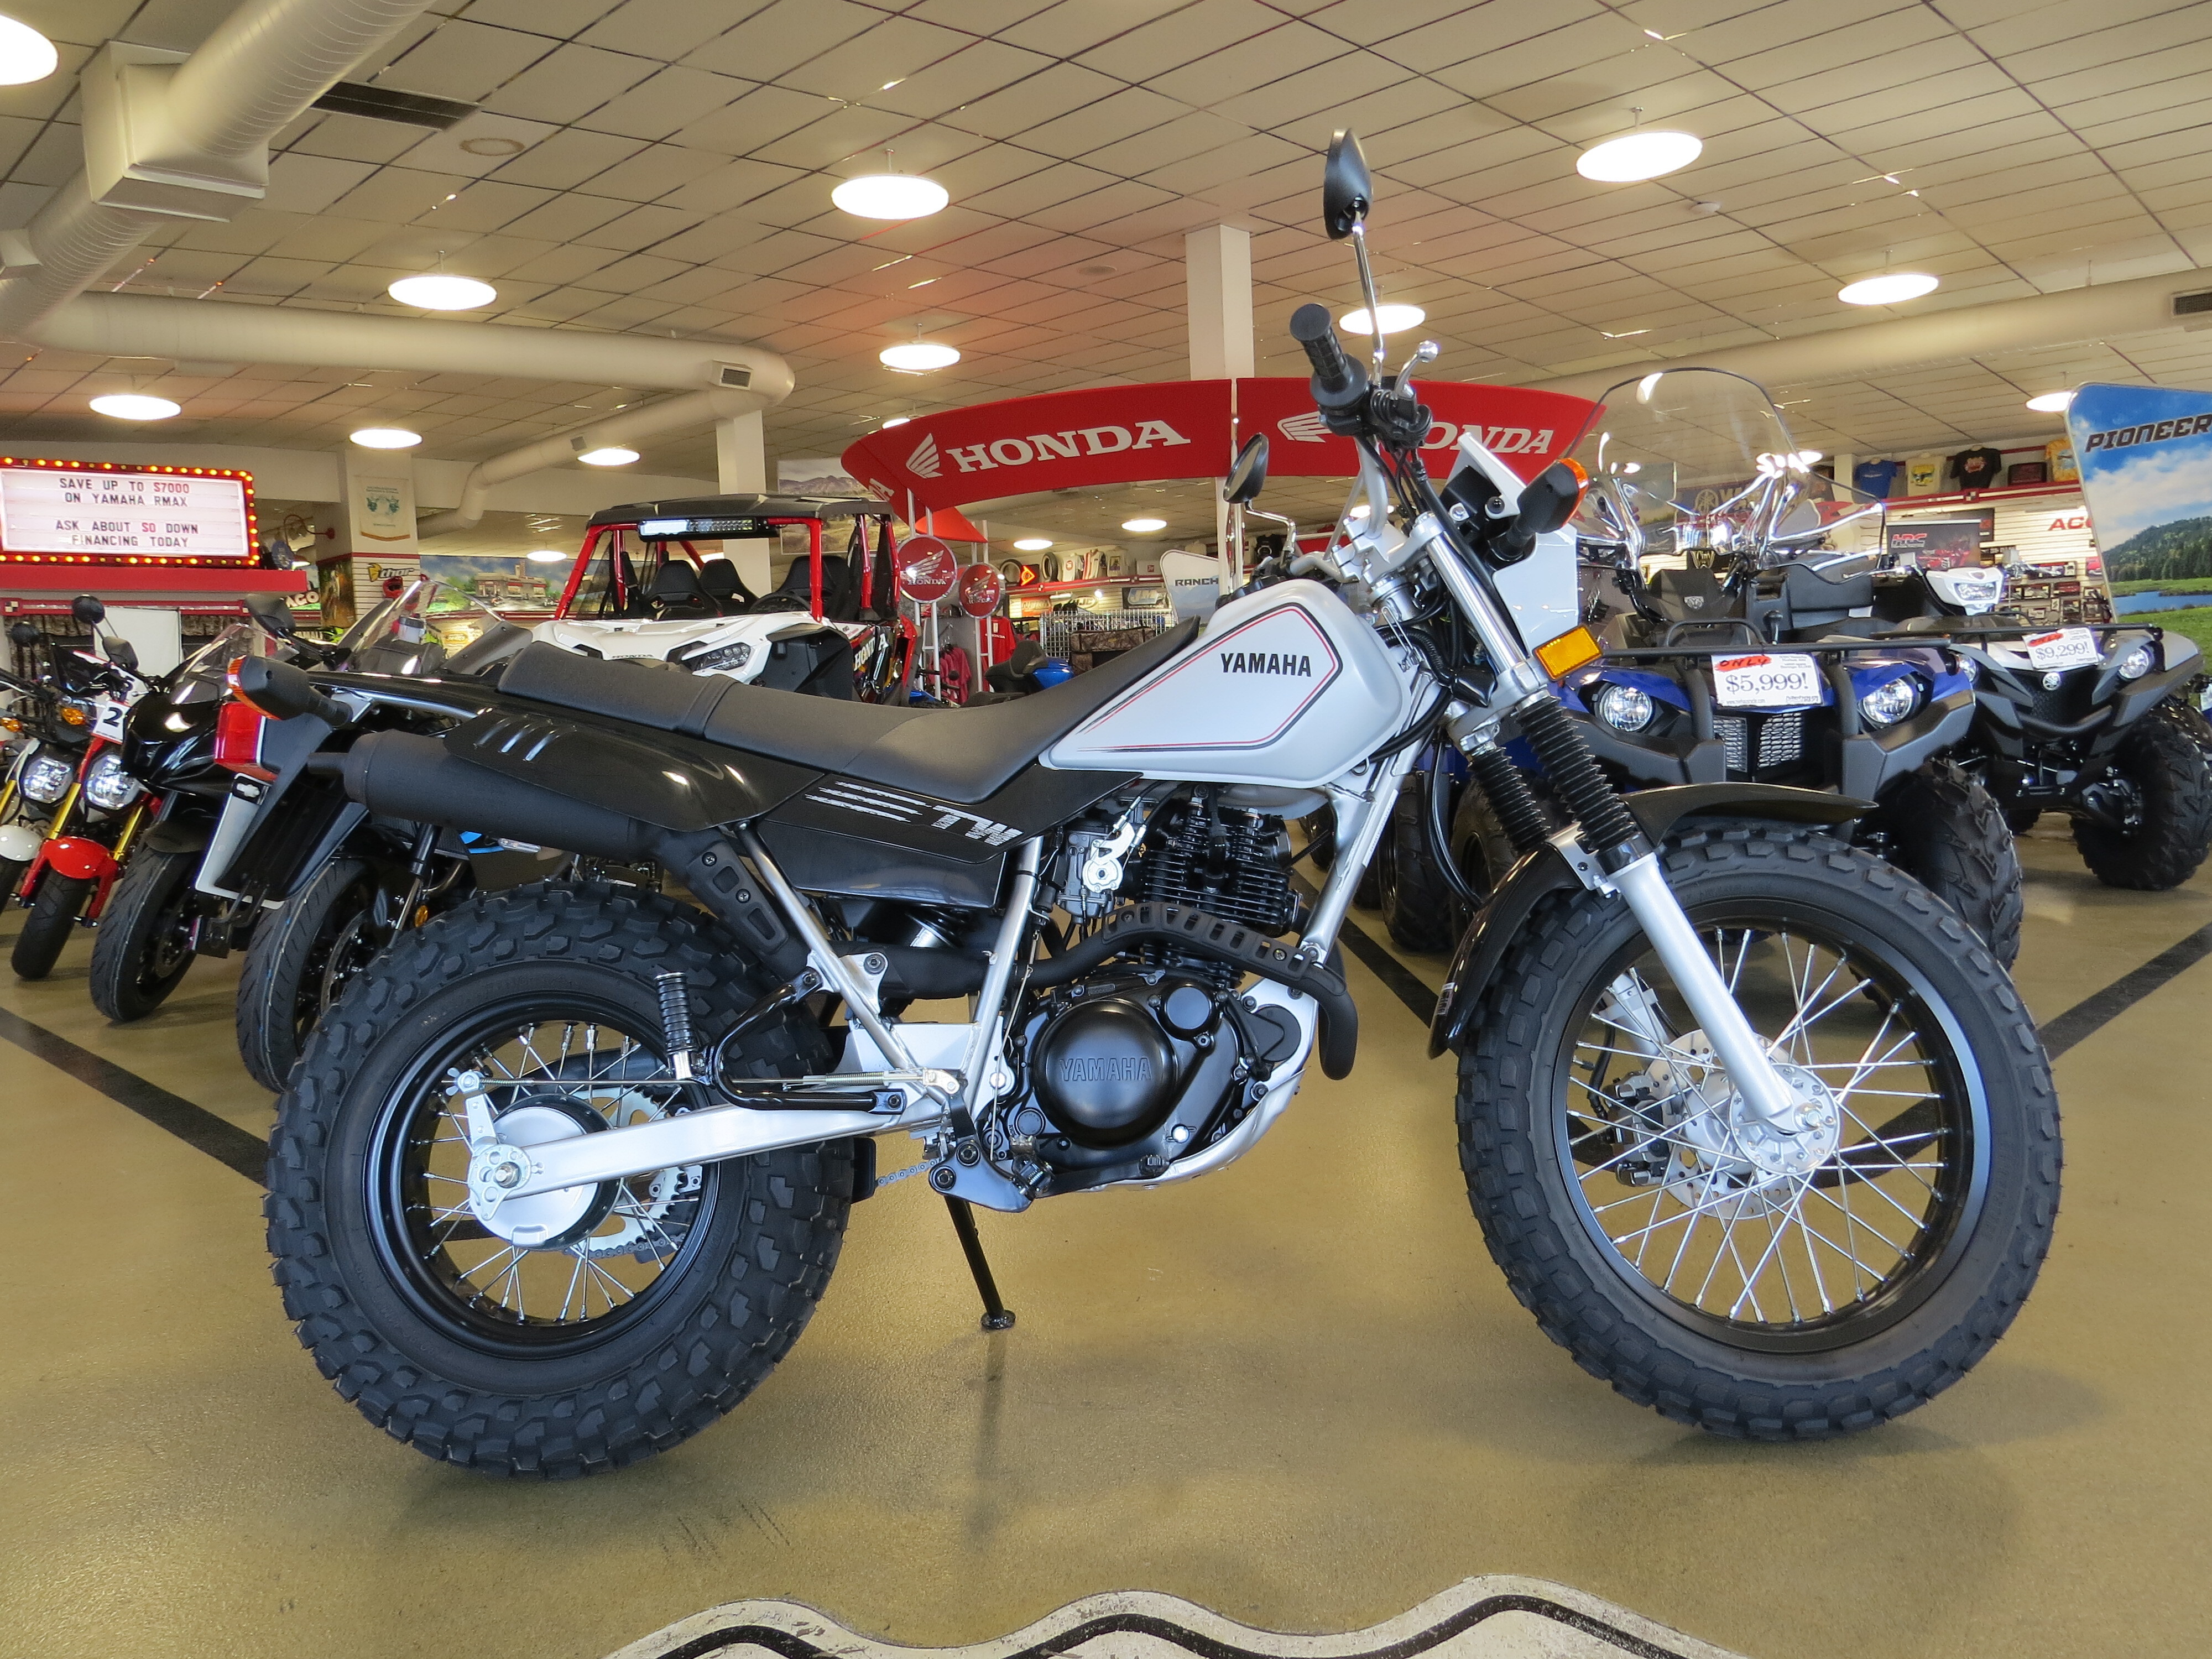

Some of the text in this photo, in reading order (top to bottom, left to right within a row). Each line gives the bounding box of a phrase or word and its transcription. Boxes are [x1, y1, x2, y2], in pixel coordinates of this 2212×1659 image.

[1418, 421, 1554, 455] ONDA
[2084, 414, 2212, 453] PIONEER
[945, 419, 1191, 473] HONDA
[59, 478, 93, 489] SAVE
[103, 480, 118, 491] UP
[129, 481, 144, 492] TO
[65, 492, 189, 507] ON YAMAHA RMAX
[55, 520, 80, 531] ASK
[91, 521, 131, 533] ABOUT
[166, 523, 199, 534] DOWN
[71, 534, 189, 547] FINANCING TODAY
[2035, 641, 2090, 661] $9,299!
[1220, 653, 1312, 677] YAMAHA
[1719, 658, 1768, 668] ONLY
[1725, 672, 1809, 695] $5,999!
[102, 706, 123, 728] 2
[931, 805, 1024, 846] TW
[1059, 1057, 1152, 1082] YAMAHA
